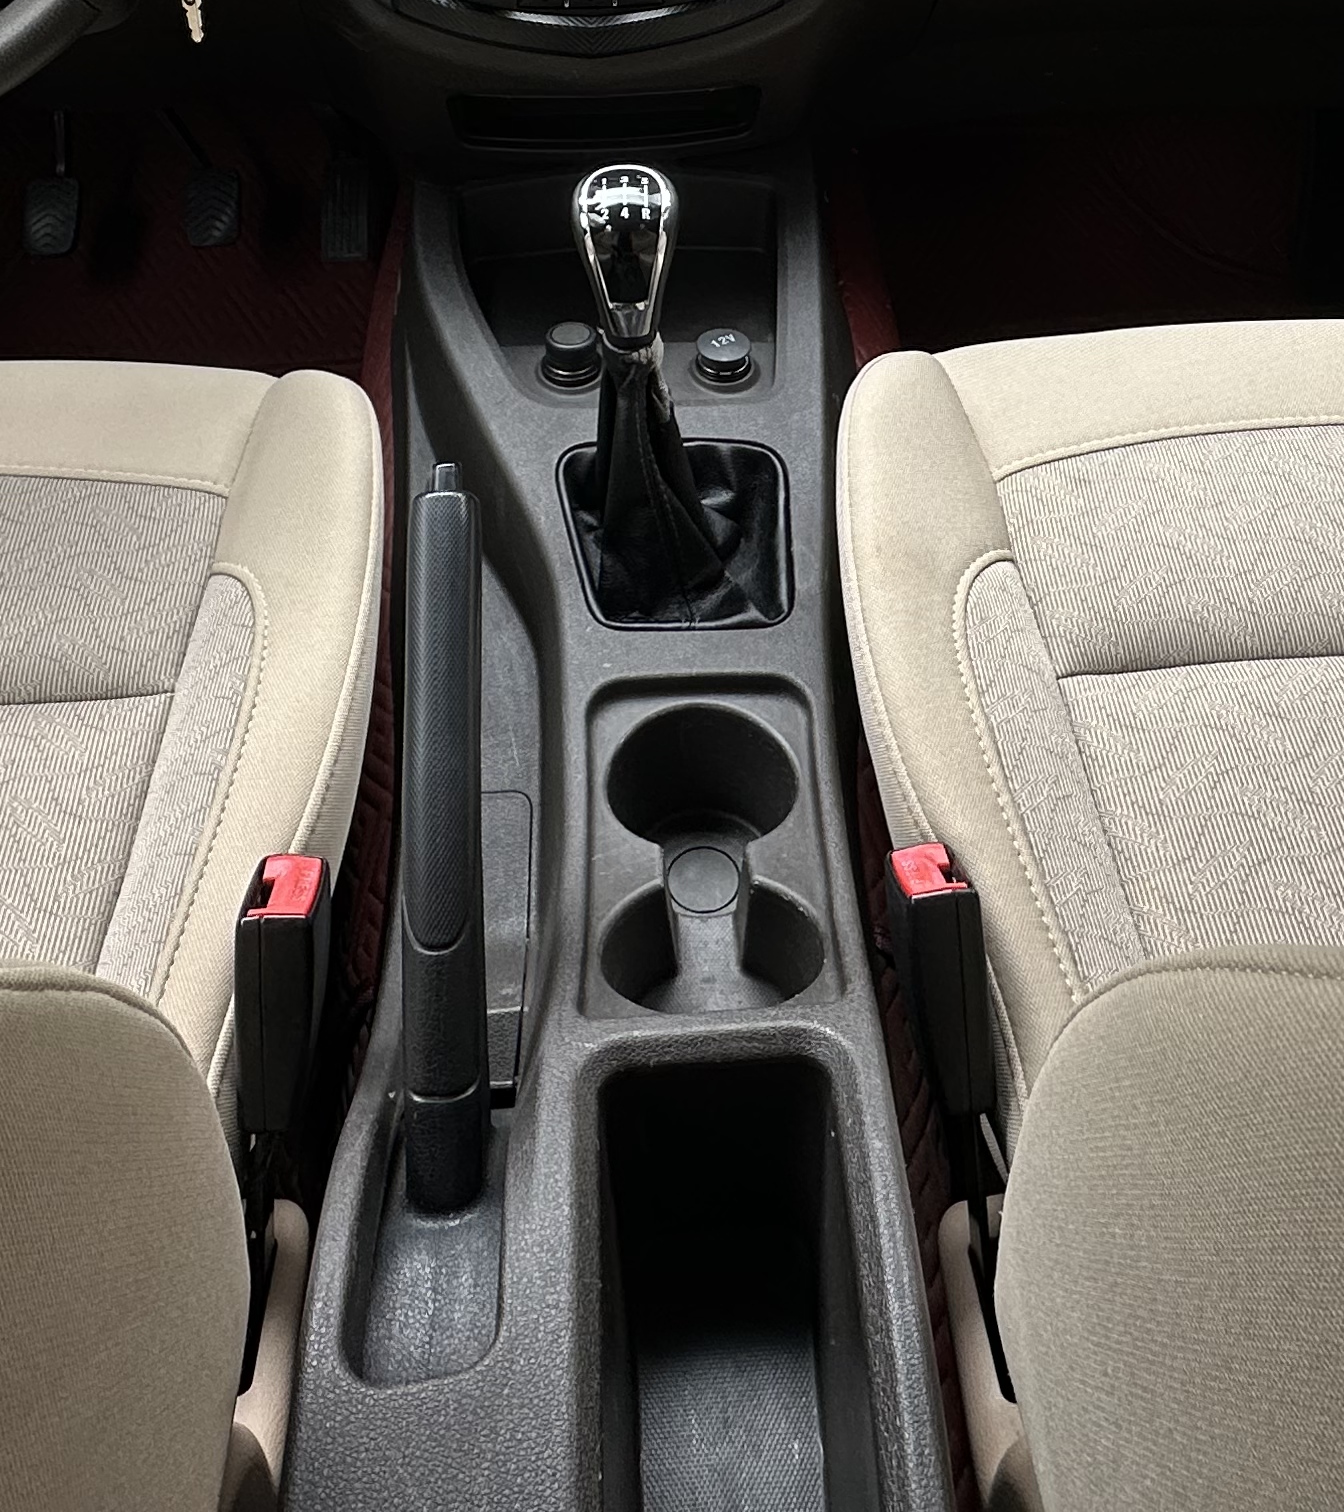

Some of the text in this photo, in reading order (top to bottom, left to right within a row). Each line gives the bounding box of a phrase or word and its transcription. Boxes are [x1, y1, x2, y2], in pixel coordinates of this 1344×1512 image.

[620, 206, 630, 220] 4
[641, 207, 651, 220] R
[710, 333, 737, 348] 12V
